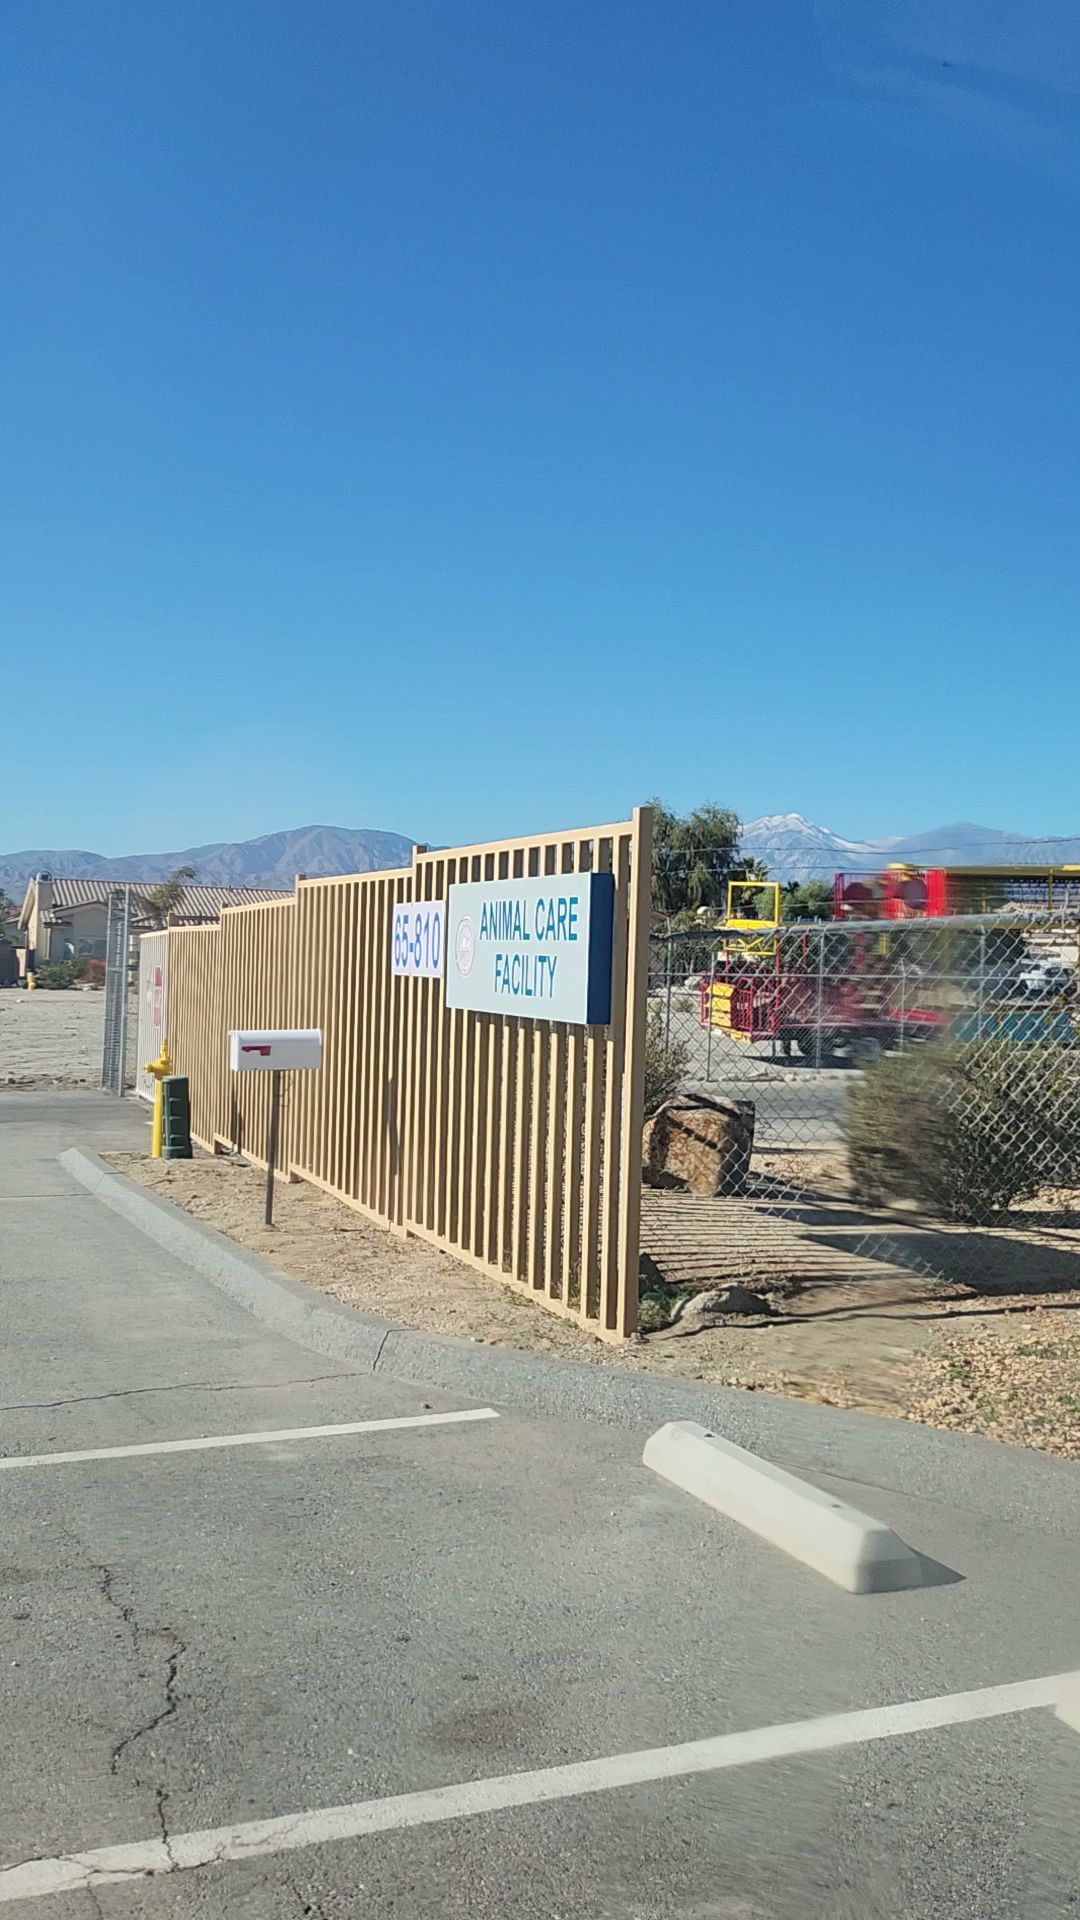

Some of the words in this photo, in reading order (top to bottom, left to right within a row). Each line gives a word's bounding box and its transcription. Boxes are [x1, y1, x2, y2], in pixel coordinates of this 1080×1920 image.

[394, 912, 440, 968] 65-810
[480, 900, 530, 941] ANIMAL
[536, 897, 578, 941] CARE
[495, 954, 557, 998] FACILITY
